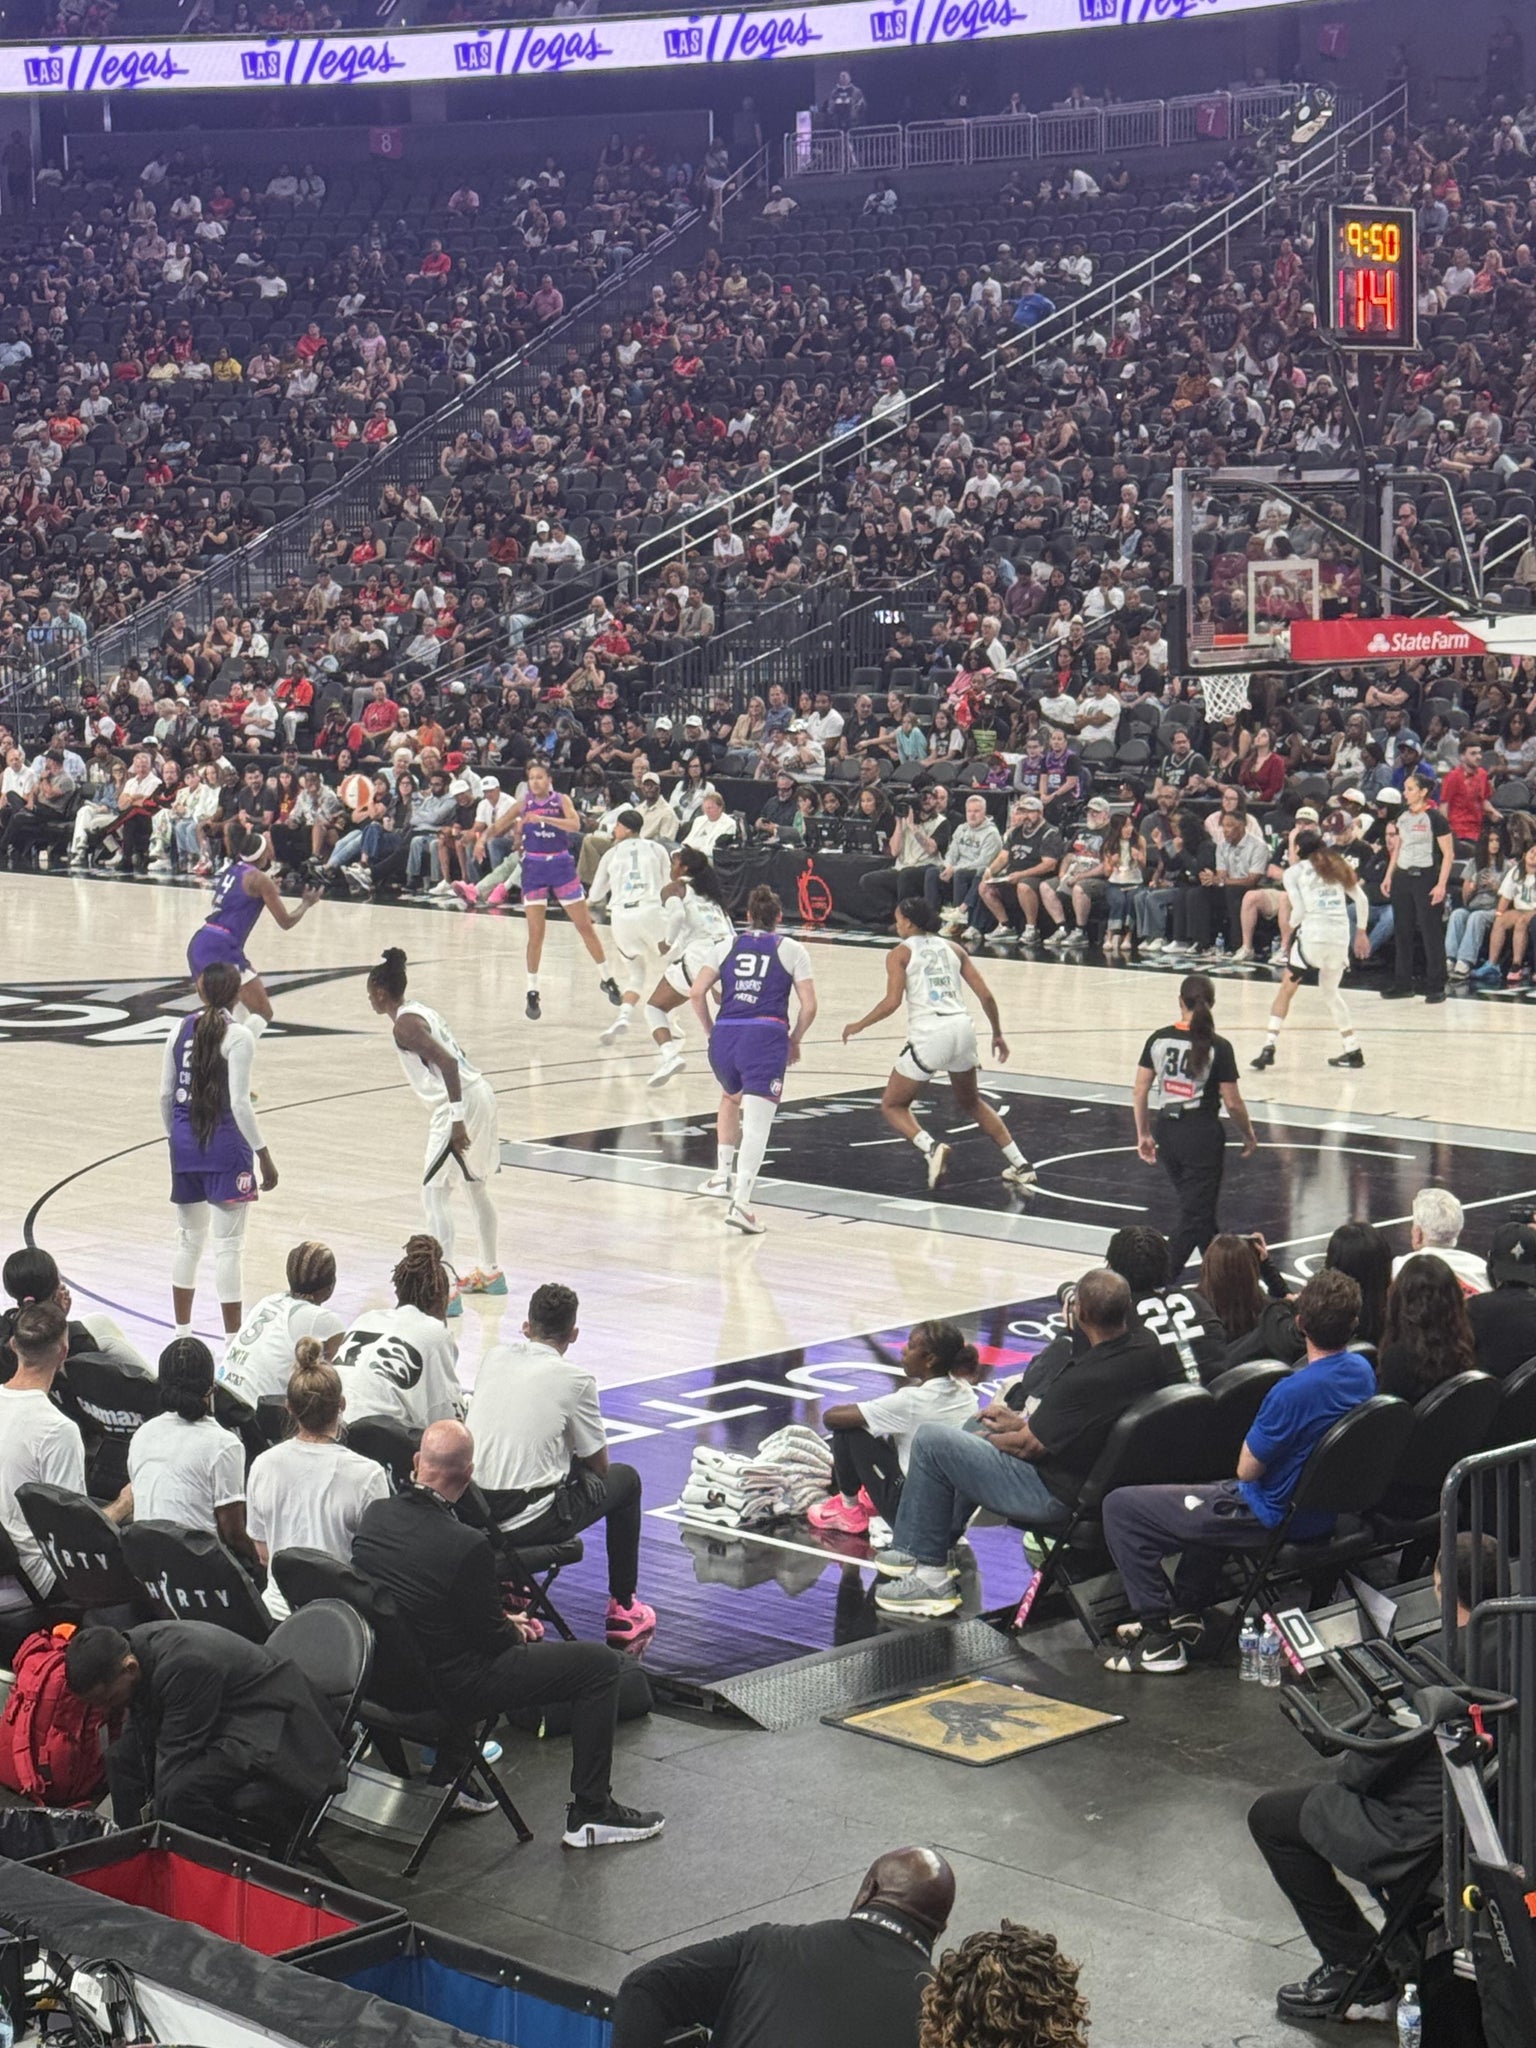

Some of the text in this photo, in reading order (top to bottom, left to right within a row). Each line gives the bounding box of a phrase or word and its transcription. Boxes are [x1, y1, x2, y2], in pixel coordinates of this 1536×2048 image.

[664, 12, 823, 62] LAS Vegas
[870, 0, 1028, 45] LAS Vegas
[24, 45, 189, 91] LAS Vegas
[241, 39, 406, 84] LAS Vegas
[454, 28, 613, 74] LAS Vegas
[1206, 108, 1216, 131] 7
[381, 132, 392, 153] 8
[1347, 222, 1399, 262] 9:50
[630, 848, 640, 871] 1
[221, 873, 236, 894] 4
[733, 953, 771, 978] 31
[920, 947, 951, 976] 21
[239, 1308, 278, 1346] 3
[1136, 1293, 1205, 1346] 22
